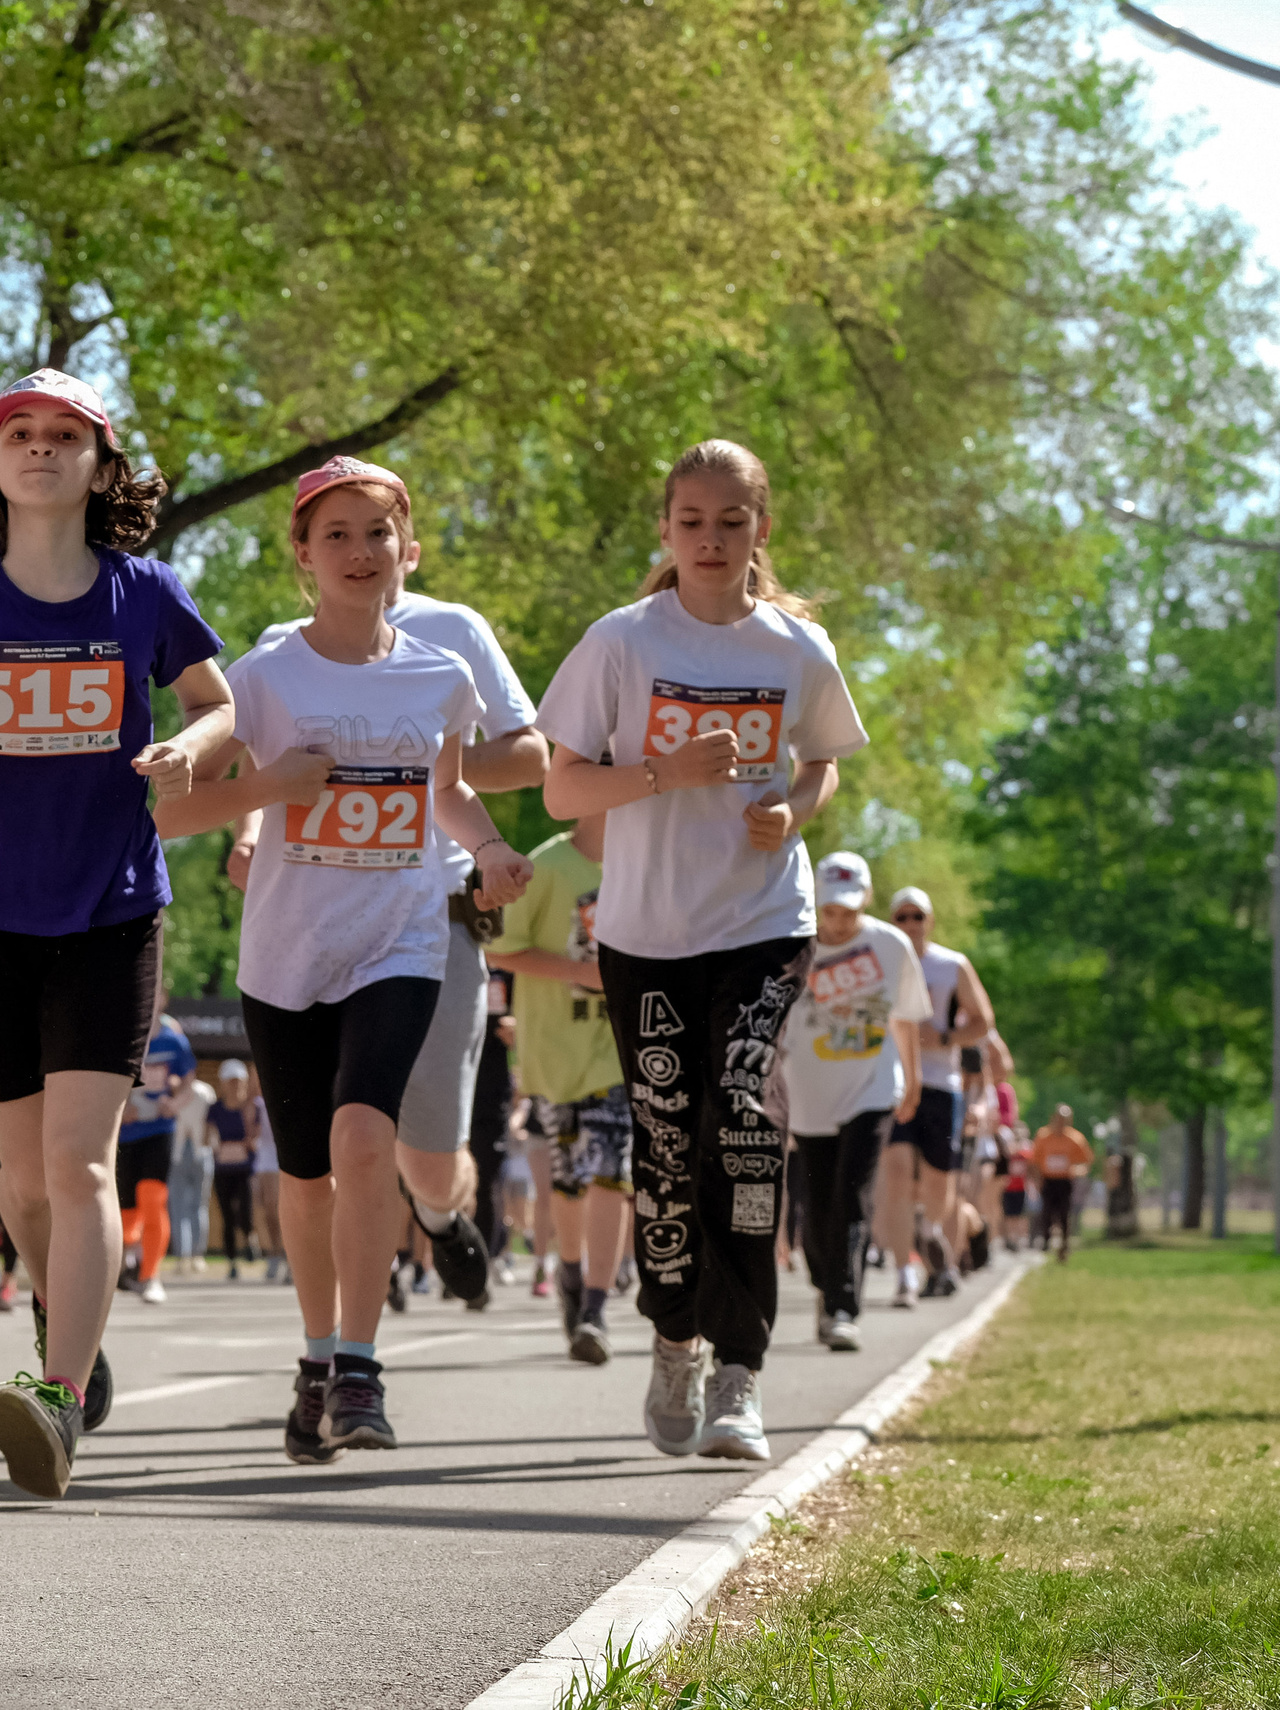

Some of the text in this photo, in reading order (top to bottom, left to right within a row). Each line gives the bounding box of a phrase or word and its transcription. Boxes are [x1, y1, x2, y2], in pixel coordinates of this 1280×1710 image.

[295, 714, 428, 762] FILA
[300, 789, 418, 845] 792
[632, 1082, 690, 1113] Black
[743, 1111, 759, 1127] to
[718, 1127, 781, 1147] Success
